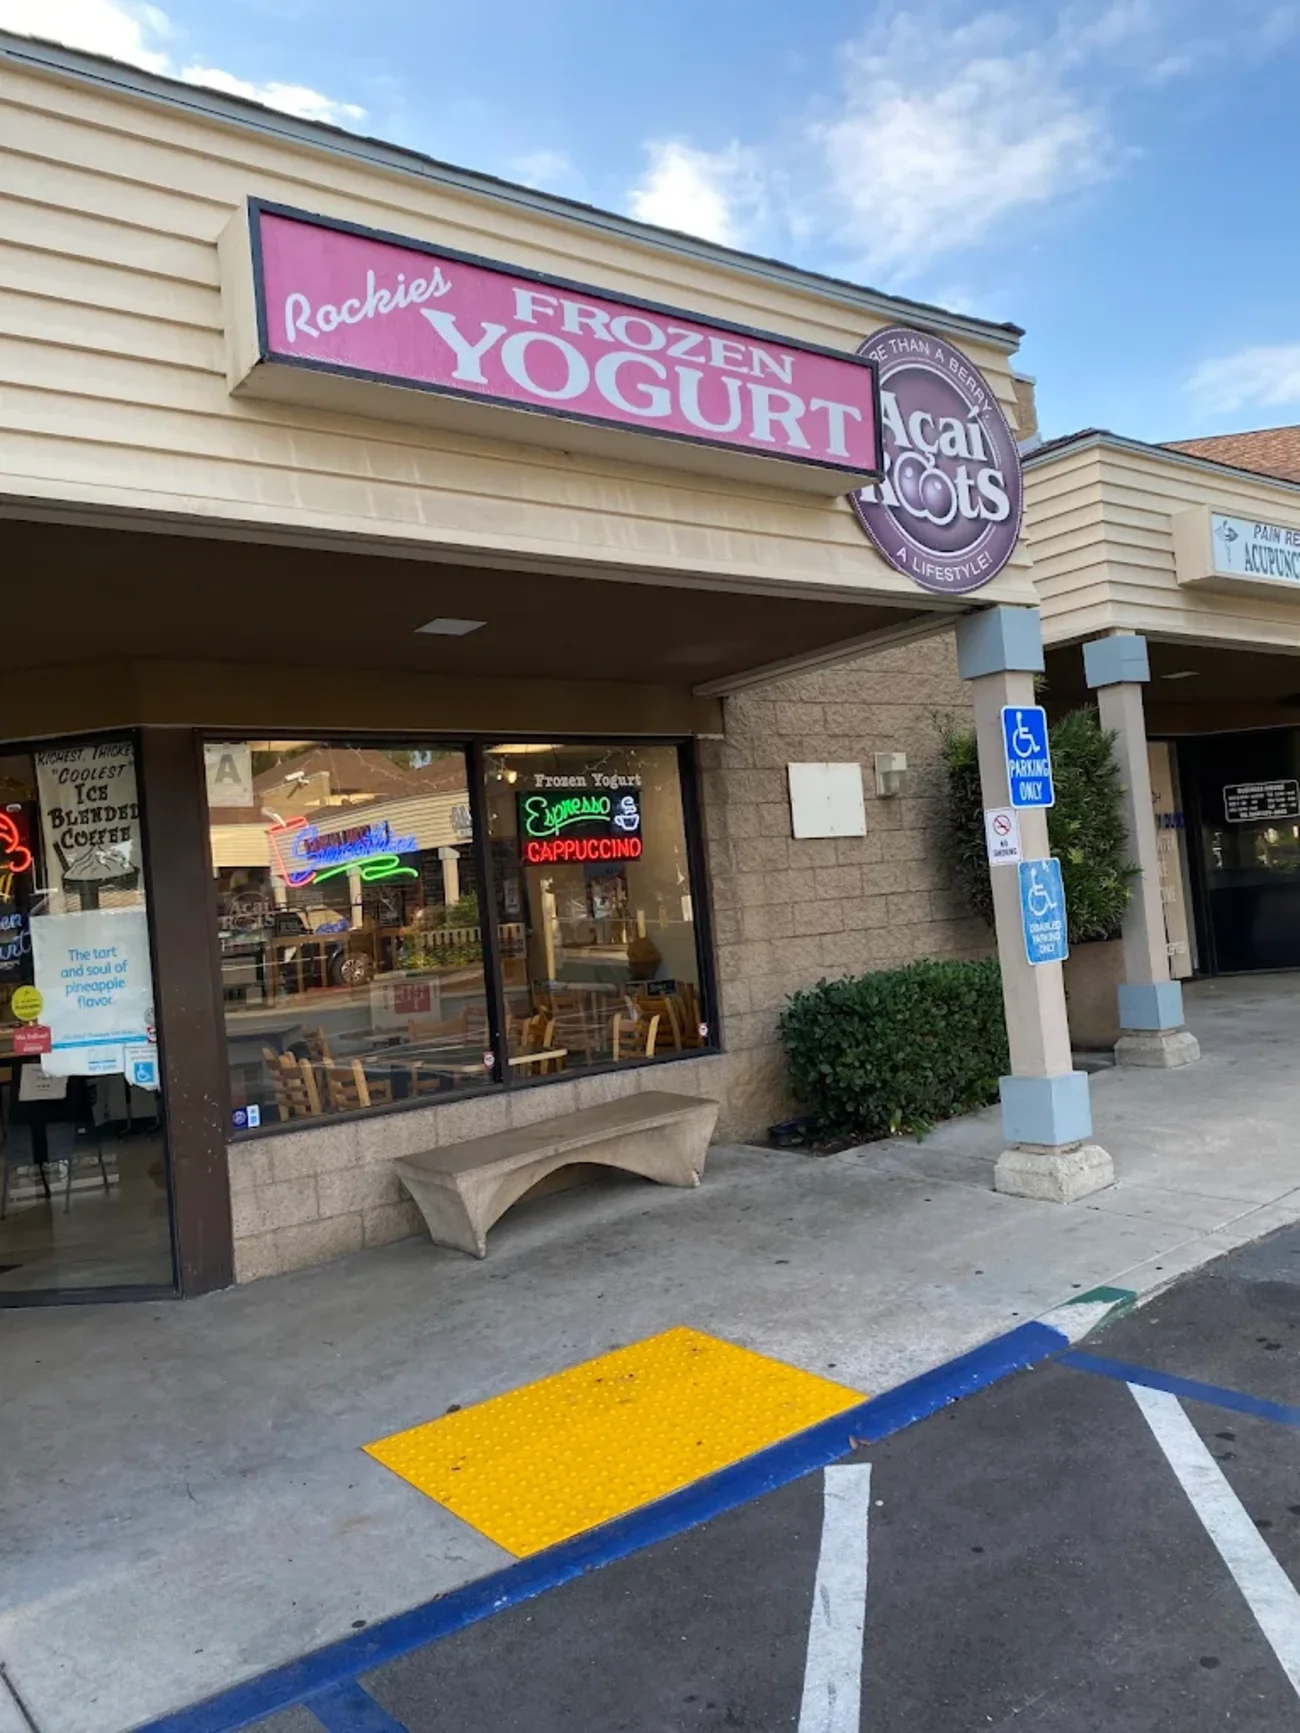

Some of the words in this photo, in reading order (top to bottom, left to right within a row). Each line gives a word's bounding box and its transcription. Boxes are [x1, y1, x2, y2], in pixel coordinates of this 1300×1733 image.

[284, 267, 452, 343] Rockies
[513, 287, 795, 385] FROZEN
[888, 337, 930, 356] THAN
[934, 348, 945, 364] A
[420, 308, 863, 458] YOGURT
[1254, 524, 1282, 543] PAIN
[896, 548, 908, 564] A
[912, 551, 993, 582] LIFESTYLE!
[214, 754, 242, 784] A
[1008, 758, 1049, 779] PARKING
[534, 774, 587, 788] Frozen
[592, 772, 642, 790] Yogurt
[1019, 780, 1043, 801] ONLY
[75, 783, 109, 804] ICE
[525, 796, 611, 836] Espresso
[61, 826, 131, 849] COFFEE
[527, 837, 642, 862] CAPPUCCINO
[68, 949, 91, 961] The
[93, 946, 118, 959] tart
[61, 964, 84, 978] and
[86, 962, 111, 976] soul
[114, 960, 128, 973] of
[65, 977, 126, 997] pineapple
